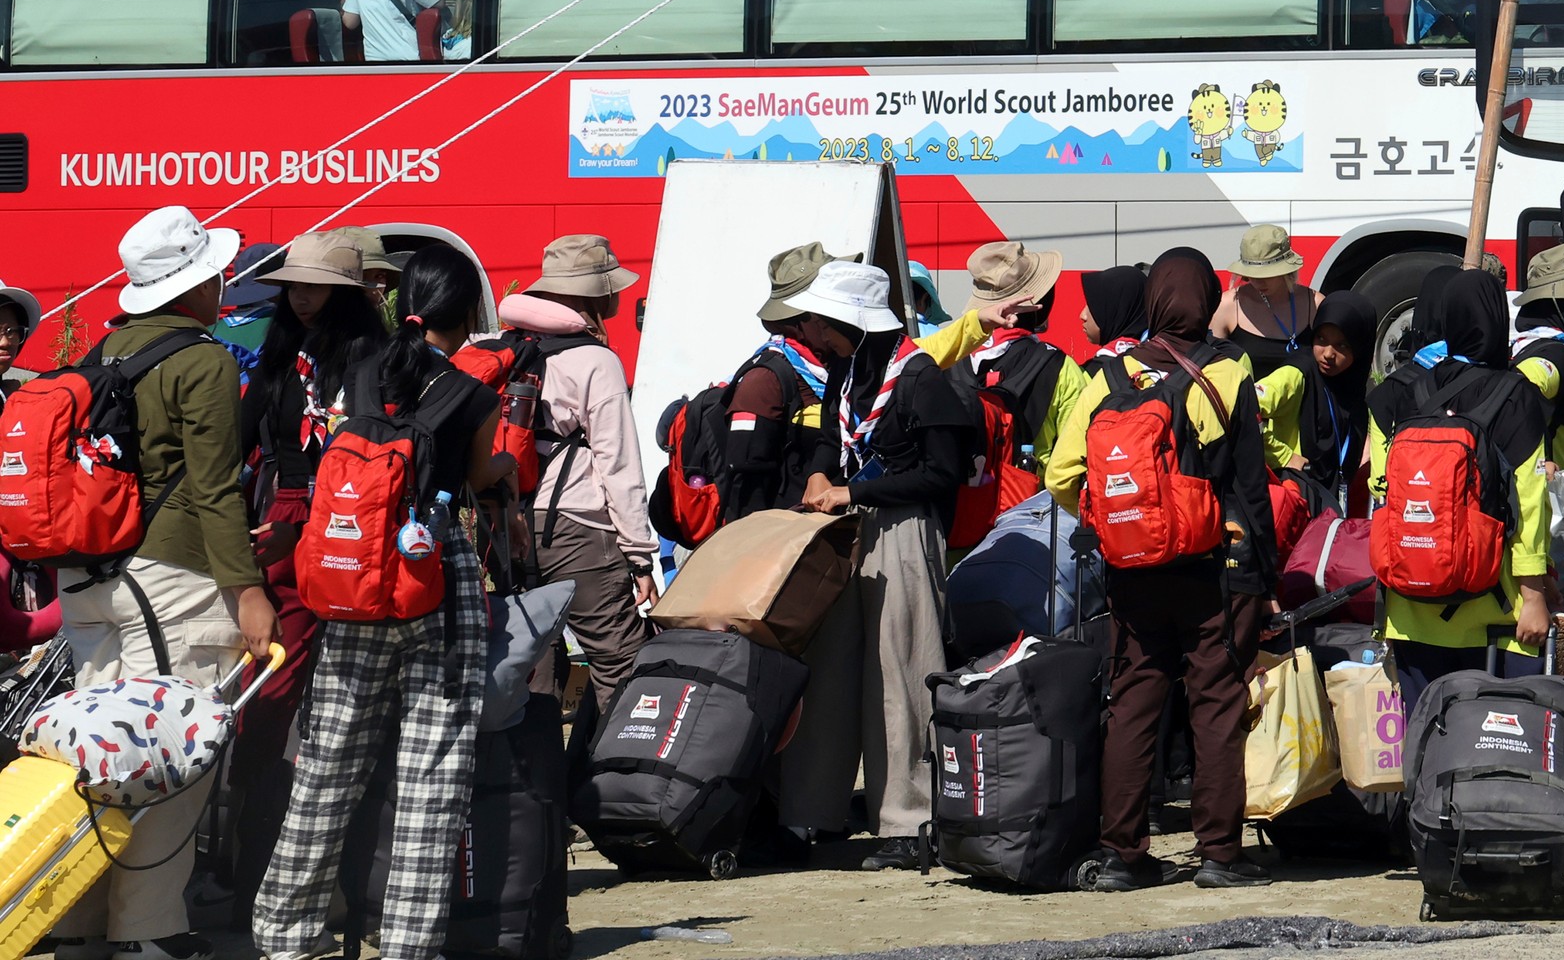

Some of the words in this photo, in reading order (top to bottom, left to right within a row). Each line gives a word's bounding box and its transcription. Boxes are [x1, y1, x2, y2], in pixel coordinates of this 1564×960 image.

[659, 93, 712, 118] 2023
[718, 91, 870, 118] SaeManGeum
[875, 90, 917, 116] 25th
[922, 88, 987, 115] World
[994, 88, 1056, 114] Scout
[1062, 86, 1174, 114] Jamboree
[819, 137, 875, 163] 2023.
[904, 136, 920, 163] 1.
[947, 136, 964, 163] 8.
[970, 136, 999, 162] 12.
[60, 150, 270, 187] KUMHOTOUR
[280, 148, 441, 184] BUSLINES
[579, 158, 596, 167] Draw
[596, 159, 612, 169] your
[321, 561, 362, 571] CONTINGENT
[323, 555, 359, 564] INDONESIA
[656, 683, 697, 759] EIGER
[1475, 743, 1534, 755] CONTINGENT
[1479, 736, 1529, 748] INDONESIA
[1378, 744, 1404, 769] al
